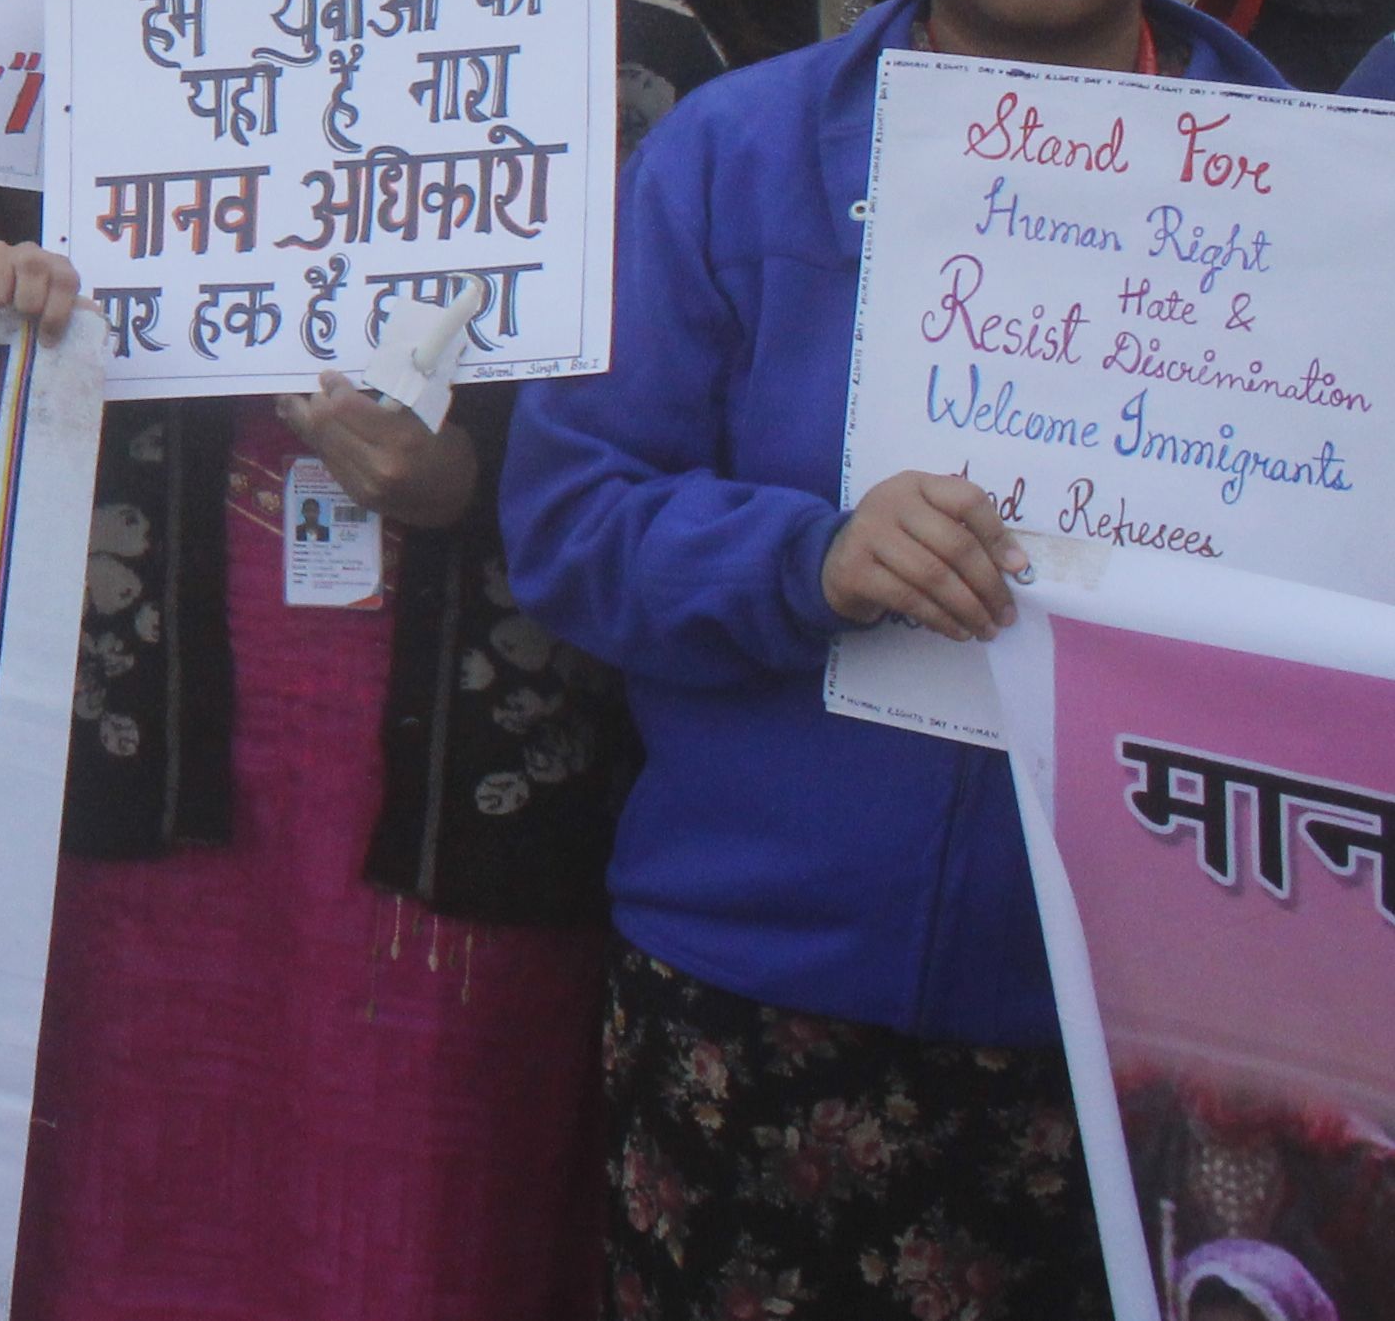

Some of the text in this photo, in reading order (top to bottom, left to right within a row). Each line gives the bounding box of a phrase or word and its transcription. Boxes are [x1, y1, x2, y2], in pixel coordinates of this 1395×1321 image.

[409, 45, 522, 124] नारा
[964, 92, 1129, 174] Stand
[94, 165, 271, 260] मानव
[975, 176, 1273, 295] Human Right
[93, 287, 170, 359] पर
[188, 281, 282, 361] हक
[920, 253, 1092, 365] Resist
[1118, 276, 1256, 333] Hate &
[925, 363, 1354, 506] Welcome Immigrants
